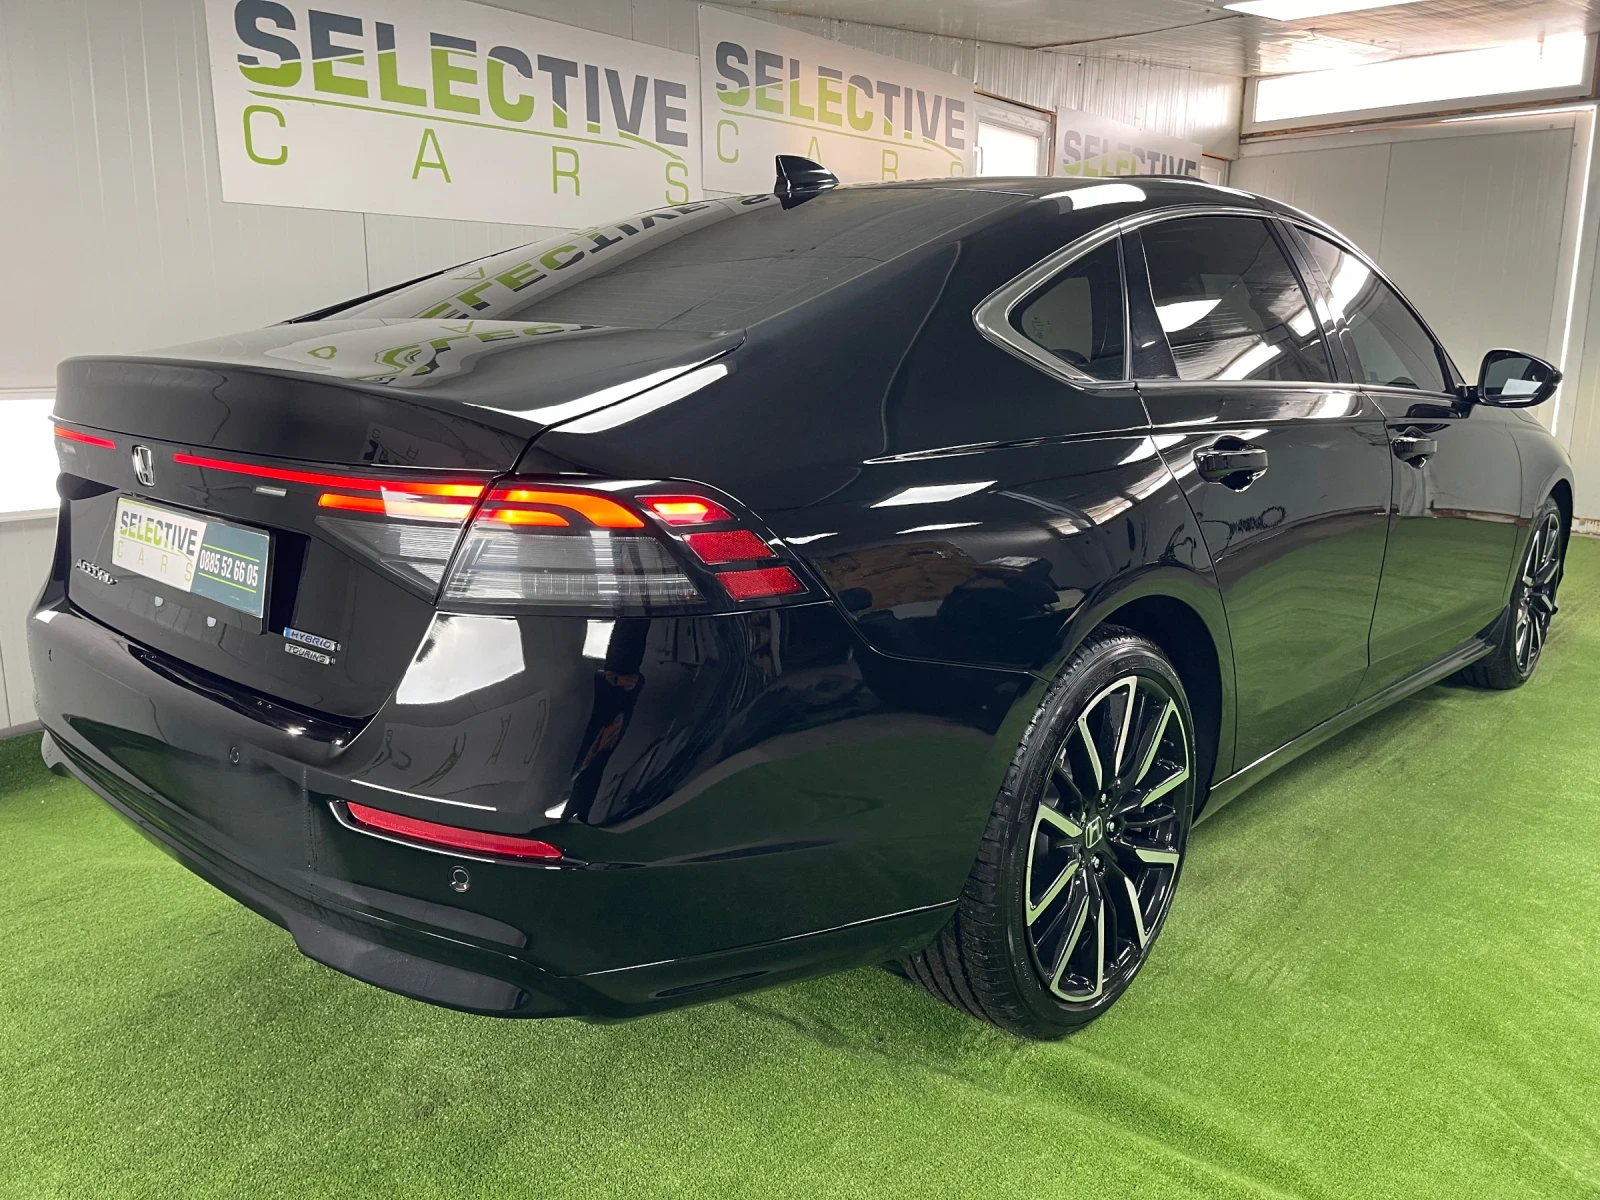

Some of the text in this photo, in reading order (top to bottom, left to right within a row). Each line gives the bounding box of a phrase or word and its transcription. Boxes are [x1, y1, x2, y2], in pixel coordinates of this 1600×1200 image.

[234, 0, 689, 148] SELECTIVE
[715, 41, 966, 150] SELECTIVE
[243, 104, 690, 206] CARS
[120, 510, 199, 557] SELECTIVE
[116, 539, 194, 583] CARS
[199, 549, 259, 587] 0885 52 66 05
[288, 644, 327, 663] TOURING
[291, 630, 331, 649] HYBRID
